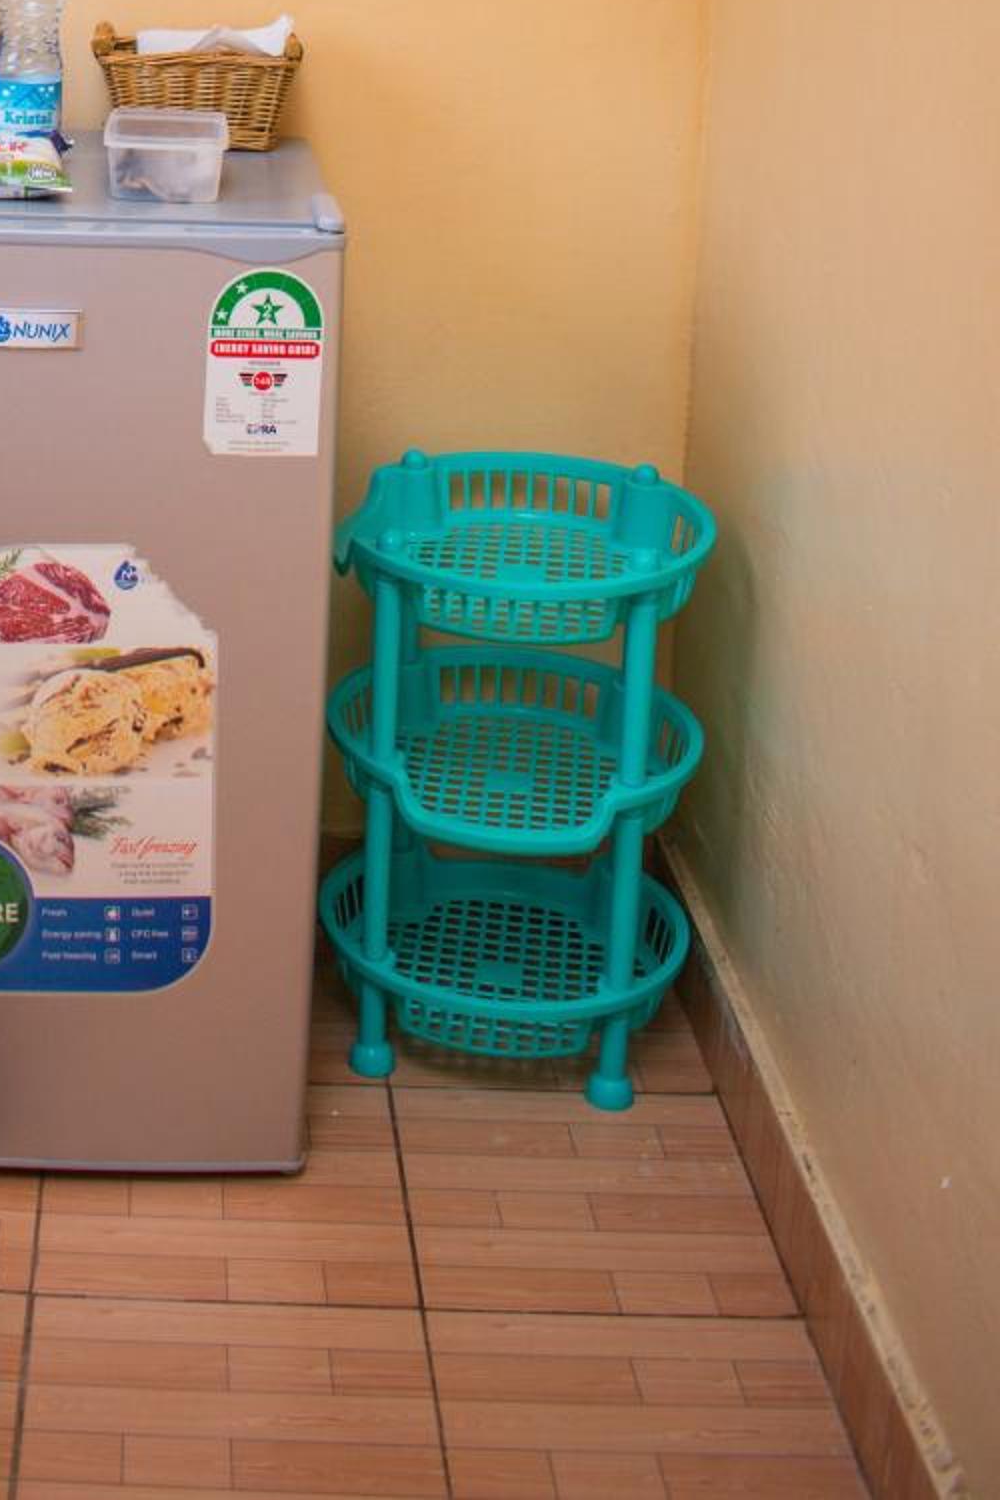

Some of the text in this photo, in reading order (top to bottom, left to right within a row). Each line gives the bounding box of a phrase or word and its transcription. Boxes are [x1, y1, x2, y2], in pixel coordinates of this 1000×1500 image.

[4, 110, 52, 126] Kristal
[263, 303, 273, 318] 2
[12, 320, 71, 342] NUNIX
[214, 343, 317, 356] ENERGY SAVING GUIDE
[41, 928, 73, 941] Energy
